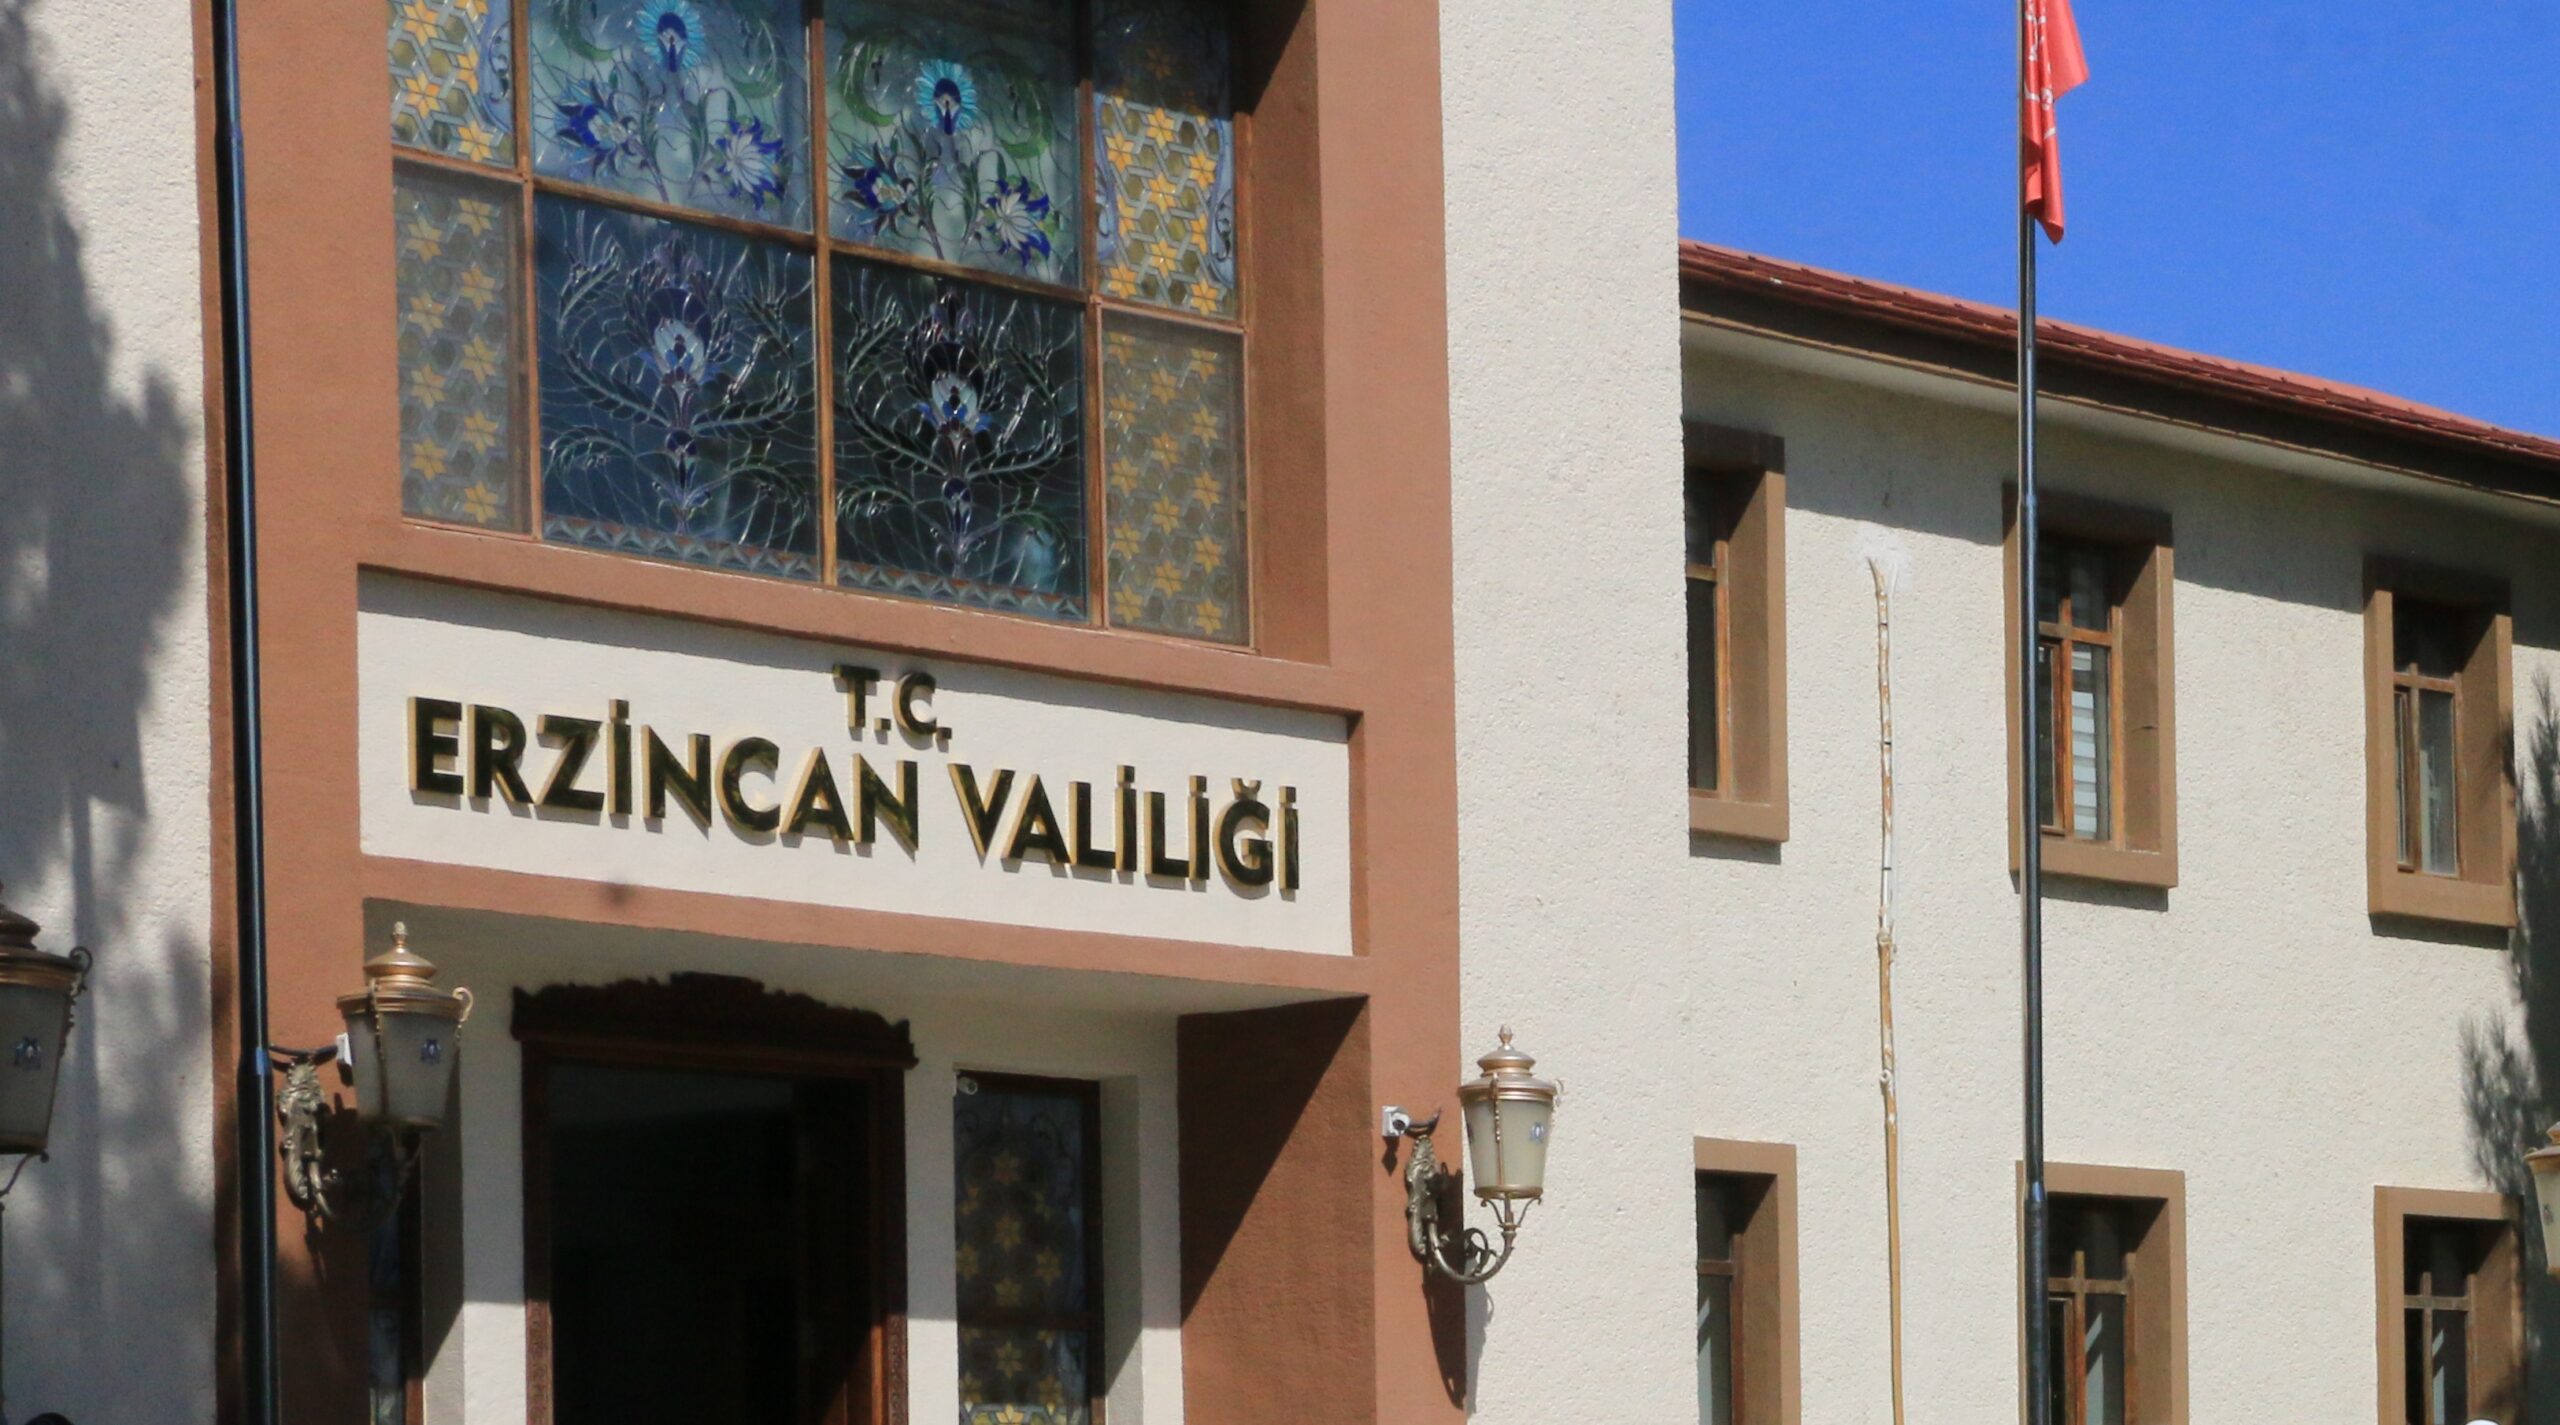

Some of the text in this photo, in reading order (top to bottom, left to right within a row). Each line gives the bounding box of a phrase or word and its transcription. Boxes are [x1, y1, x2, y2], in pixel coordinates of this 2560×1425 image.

[833, 664, 953, 741] T.C.
[407, 695, 1299, 890] ERZİNCAN VALİLİĞİ
